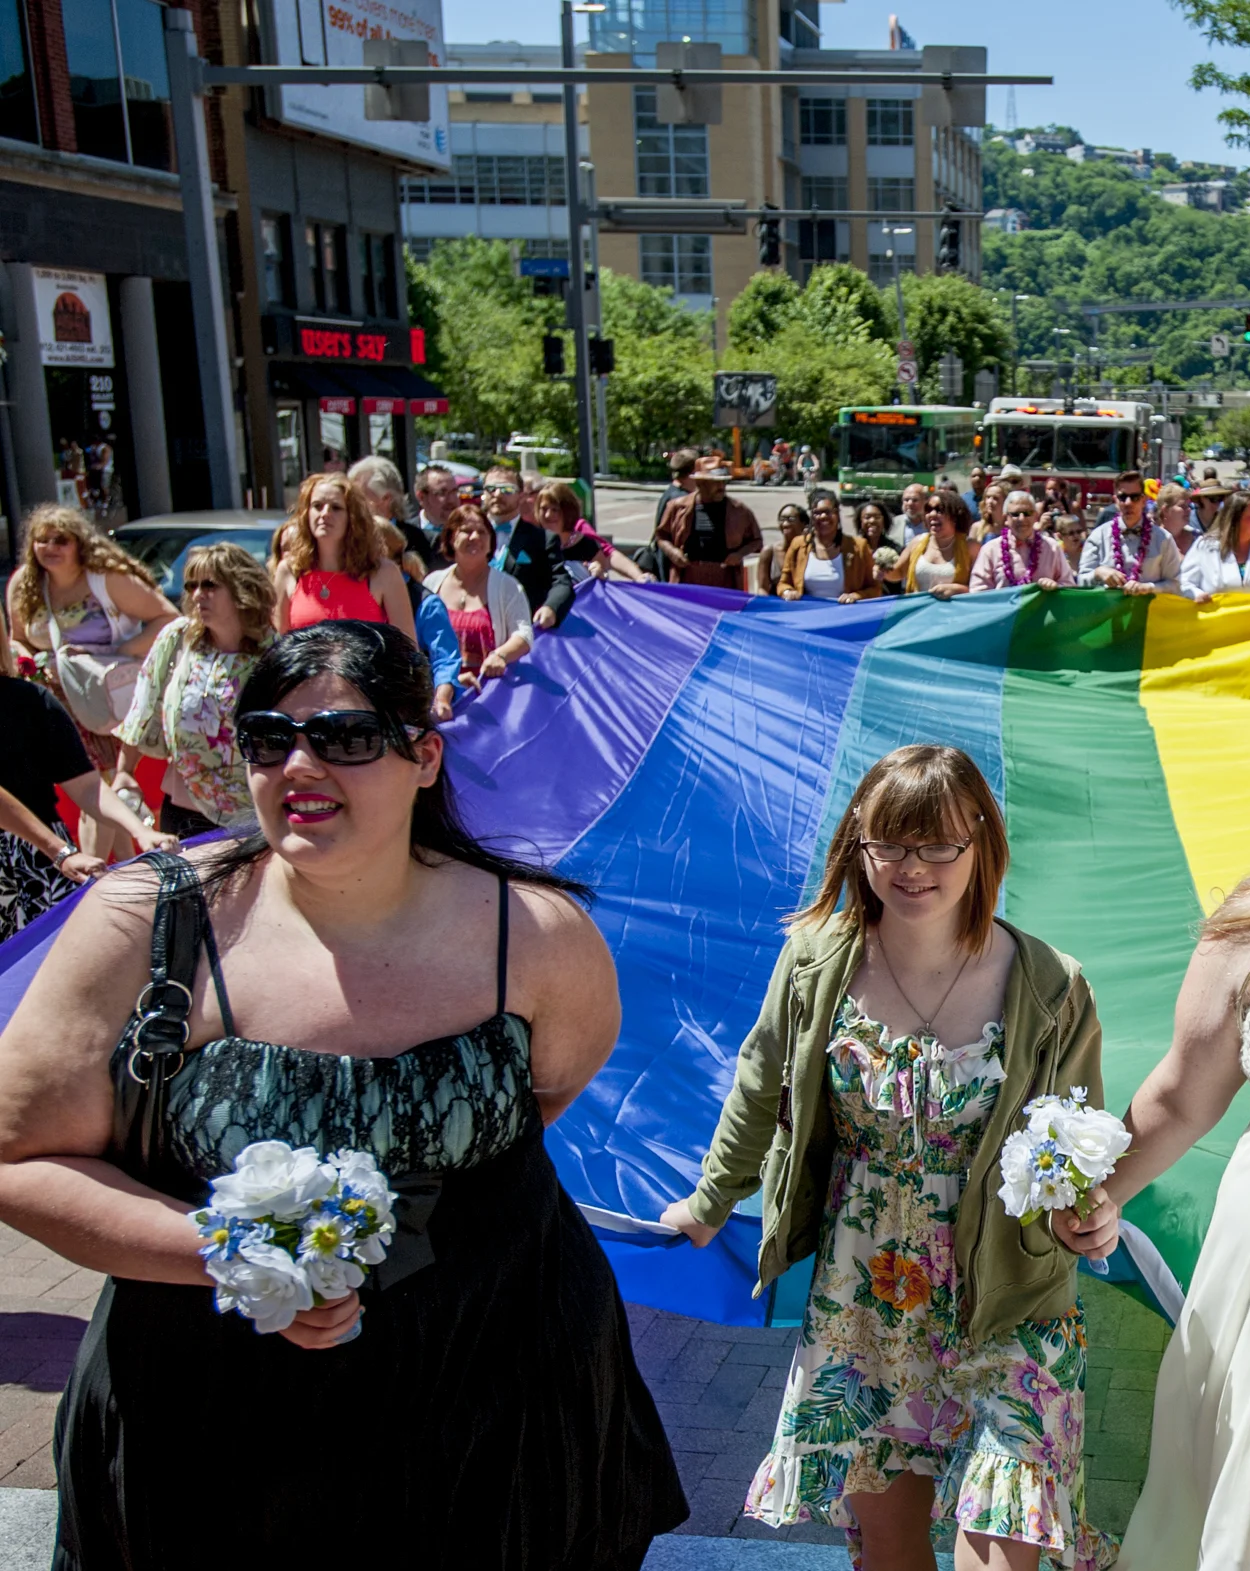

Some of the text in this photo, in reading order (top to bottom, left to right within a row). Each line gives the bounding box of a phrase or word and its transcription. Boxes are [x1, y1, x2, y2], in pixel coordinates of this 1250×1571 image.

[328, 5, 354, 34] 99%
[356, 18, 368, 38] of
[89, 375, 113, 392] 210
